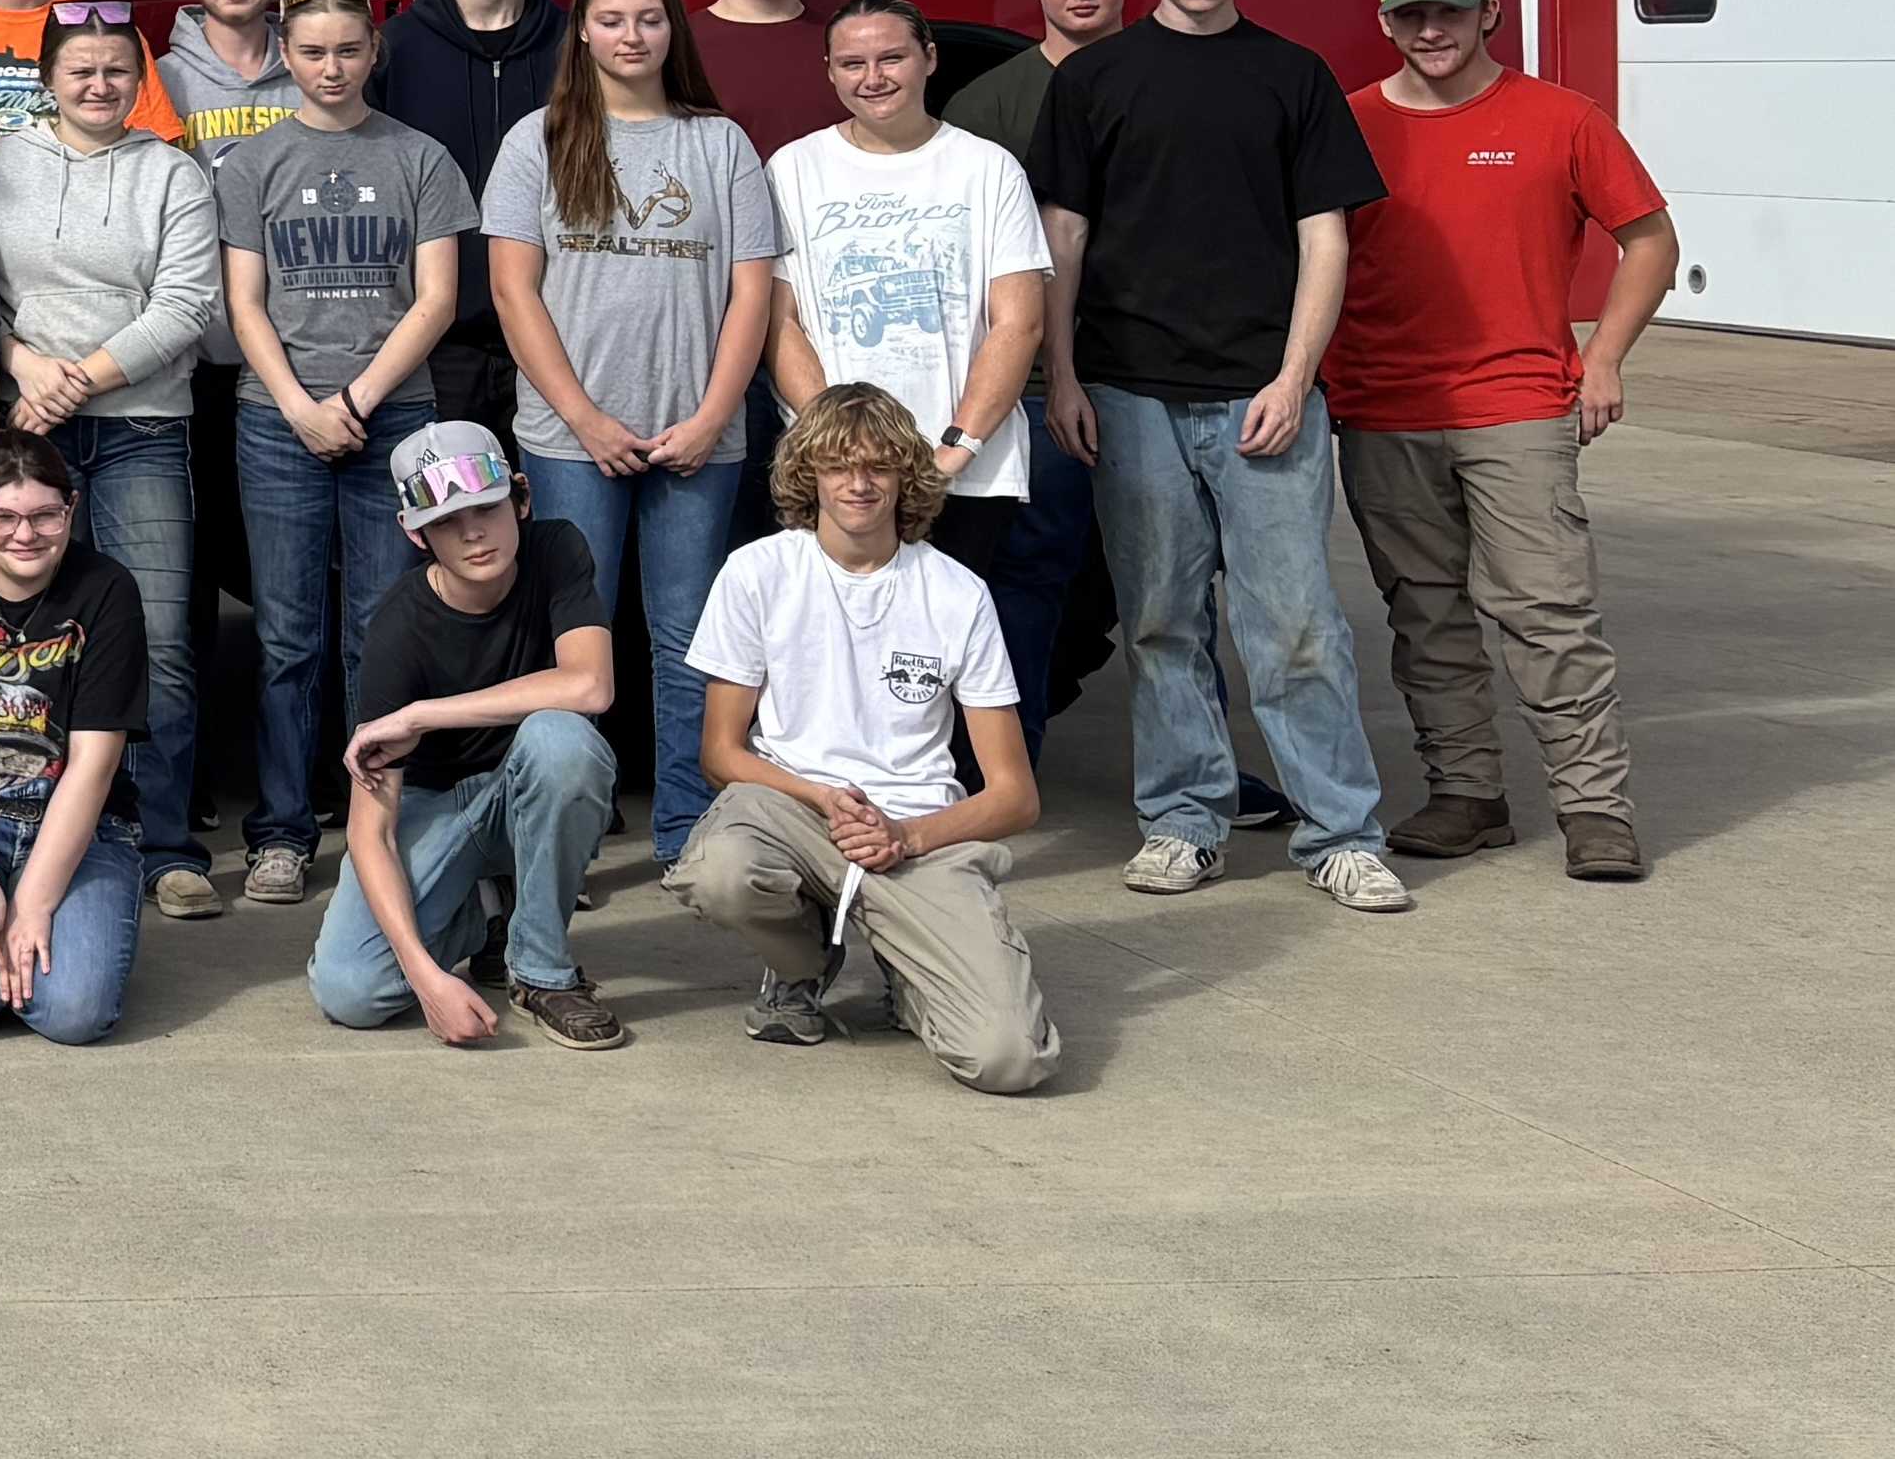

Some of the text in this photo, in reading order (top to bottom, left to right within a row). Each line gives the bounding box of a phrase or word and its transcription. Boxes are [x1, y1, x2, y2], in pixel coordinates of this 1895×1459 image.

[269, 215, 409, 268] NEW ULM
[810, 201, 971, 241] Bronco
